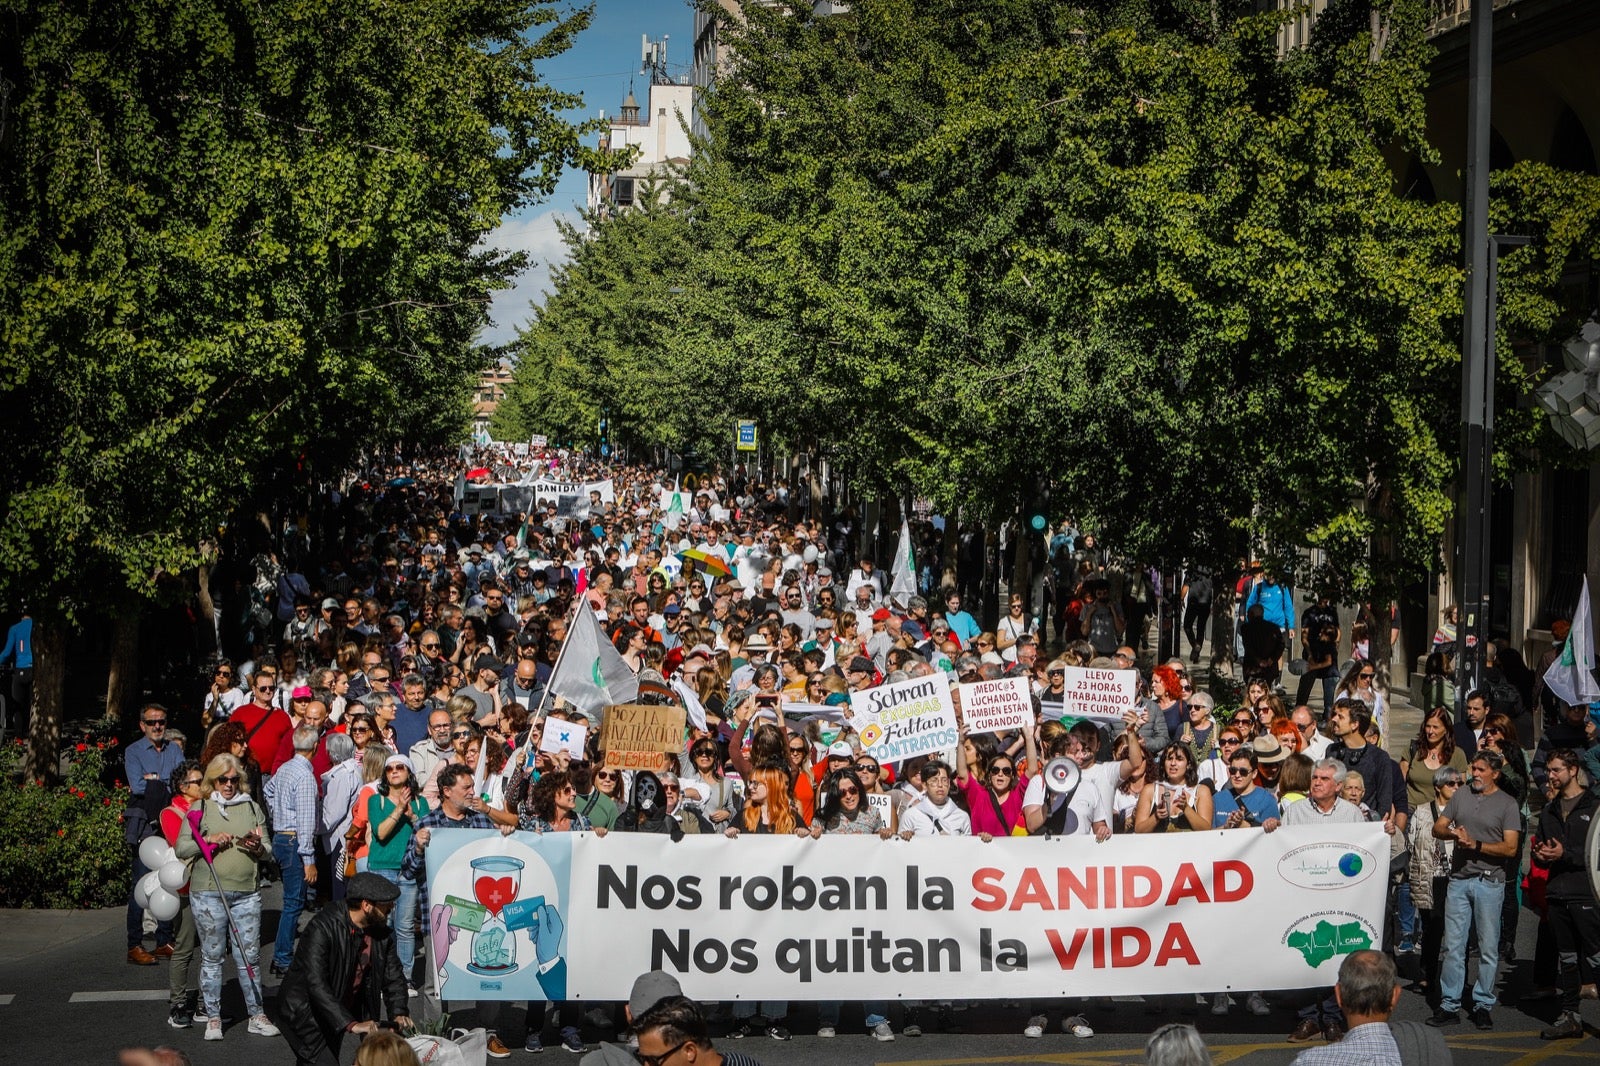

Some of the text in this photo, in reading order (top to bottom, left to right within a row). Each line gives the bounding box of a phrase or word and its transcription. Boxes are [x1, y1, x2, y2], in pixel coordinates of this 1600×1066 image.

[537, 484, 580, 493] SANIDA
[1086, 670, 1114, 680] LLEVO
[1077, 681, 1122, 692] 23 HORAS
[868, 681, 938, 714] Sobran
[971, 692, 1020, 706] LUCHANDO,
[1067, 691, 1131, 705] TRABAJANDO,
[612, 706, 660, 725] SOY LA
[880, 697, 942, 724] EXCUSAS
[1090, 704, 1120, 714] CURO?
[976, 715, 1022, 729] CURANDO!
[884, 717, 946, 744] Faltan
[866, 727, 957, 760] CONTRATOS
[606, 752, 664, 768] OS ESPERO
[597, 860, 1254, 912] Nos roban la SANIDAD
[506, 906, 524, 916] VISA
[1310, 910, 1336, 918] ANDALUZA
[650, 922, 1202, 982] Nos quitan la VIDA
